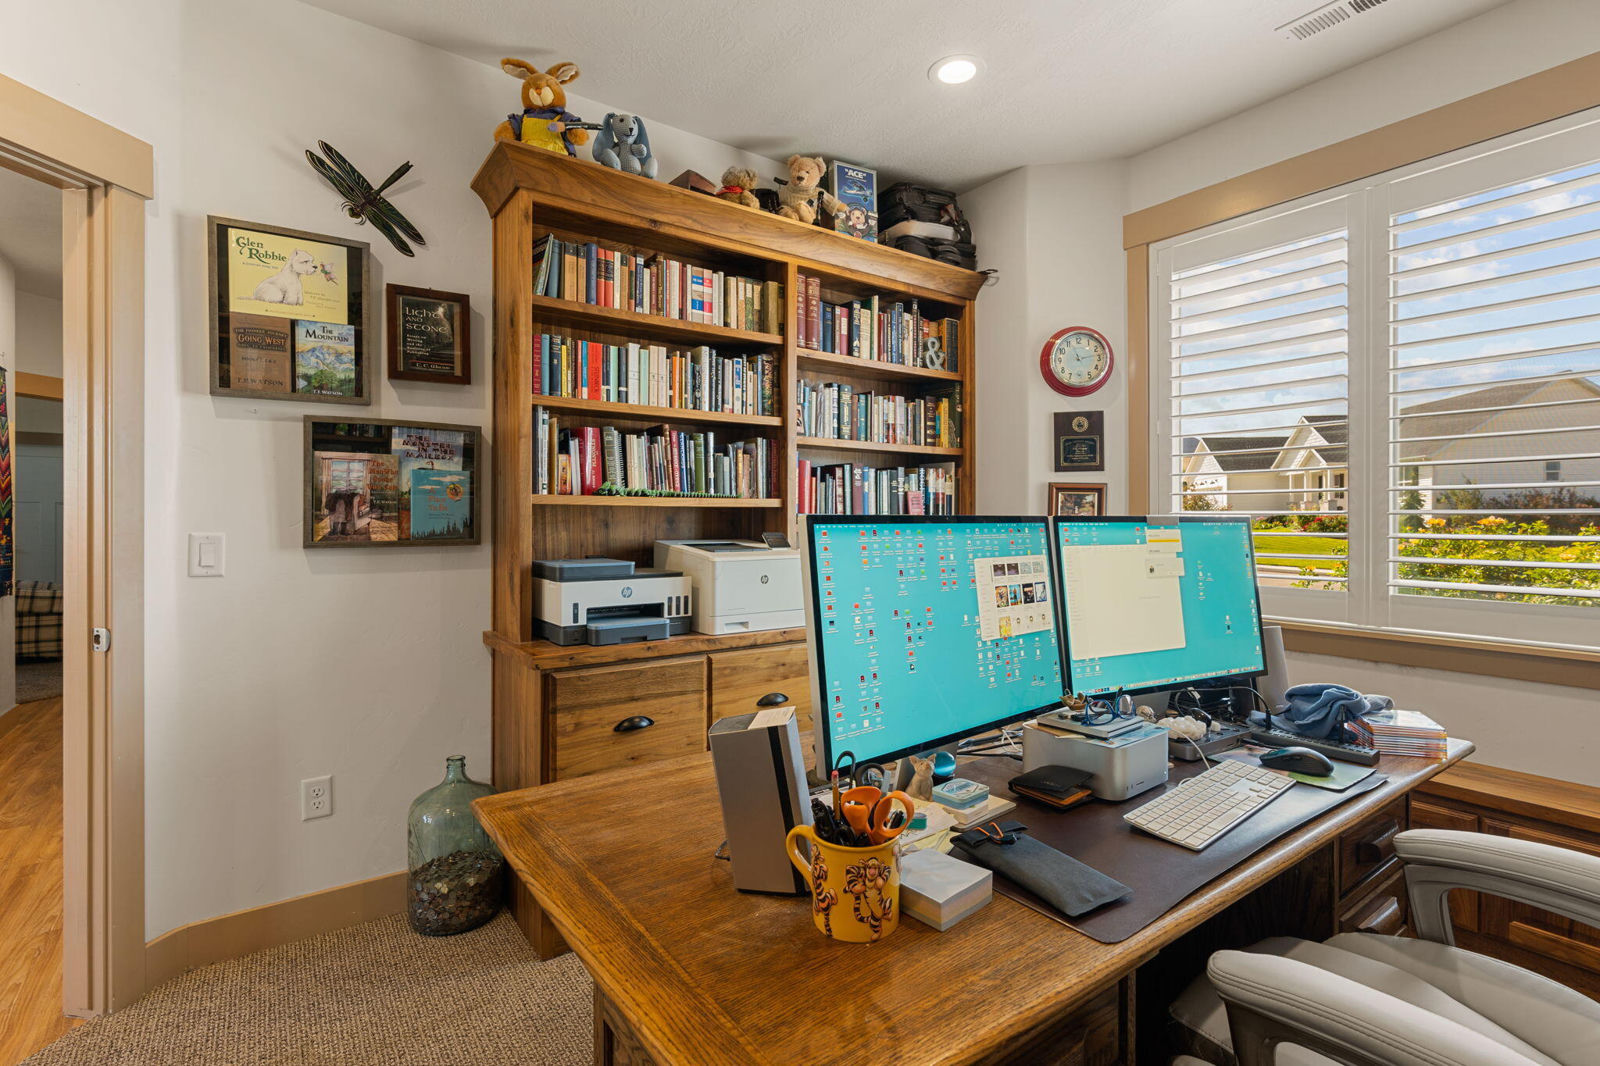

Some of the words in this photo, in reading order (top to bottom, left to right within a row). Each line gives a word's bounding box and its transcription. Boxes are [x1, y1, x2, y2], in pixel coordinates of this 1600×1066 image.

[235, 236, 264, 255] Glen
[248, 247, 288, 264] Robbie
[238, 334, 262, 343] GOING
[265, 336, 286, 345] WEST
[305, 329, 349, 342] MOUNTAIN
[761, 575, 769, 584] hp
[621, 586, 632, 598] hp
